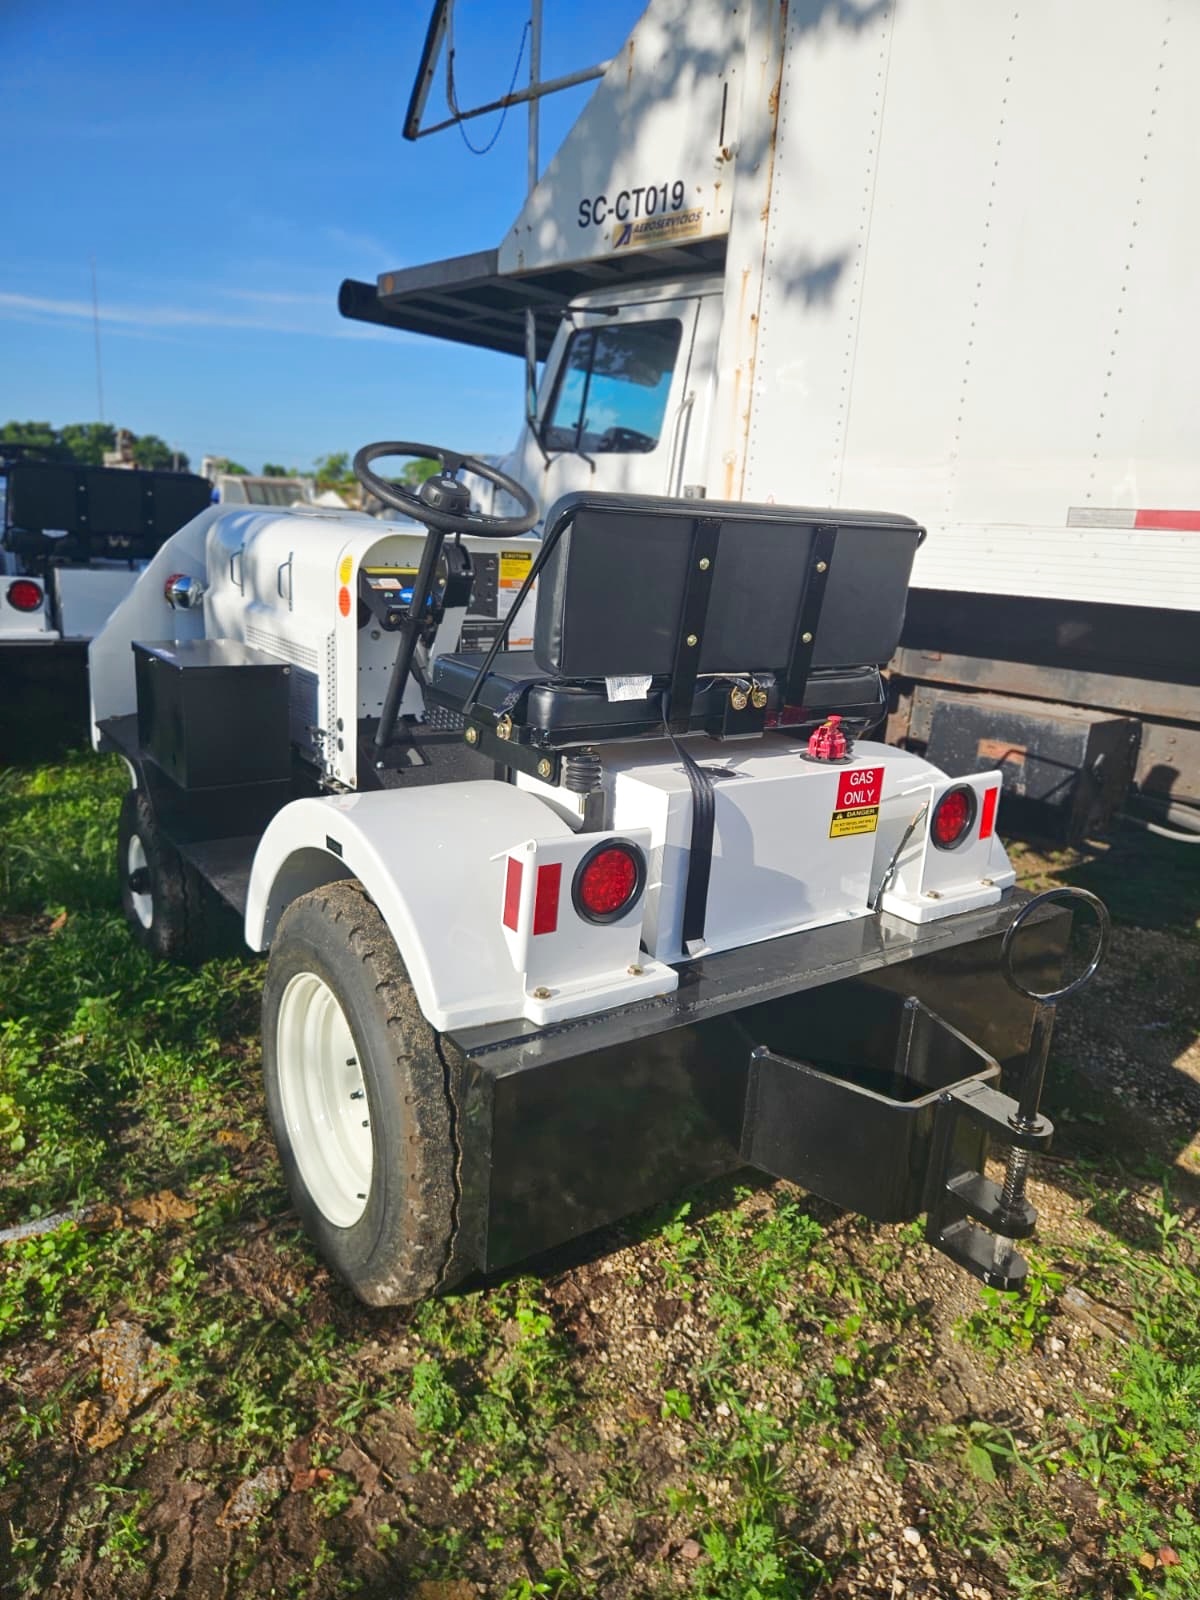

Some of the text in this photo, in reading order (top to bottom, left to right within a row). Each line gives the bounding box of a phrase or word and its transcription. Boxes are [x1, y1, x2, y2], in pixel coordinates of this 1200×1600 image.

[578, 180, 685, 228] SC-CT019
[633, 211, 702, 233] AEROSERVICIOS
[850, 771, 874, 786] GAS
[843, 789, 875, 805] ONLY
[846, 808, 875, 818] DANGER
